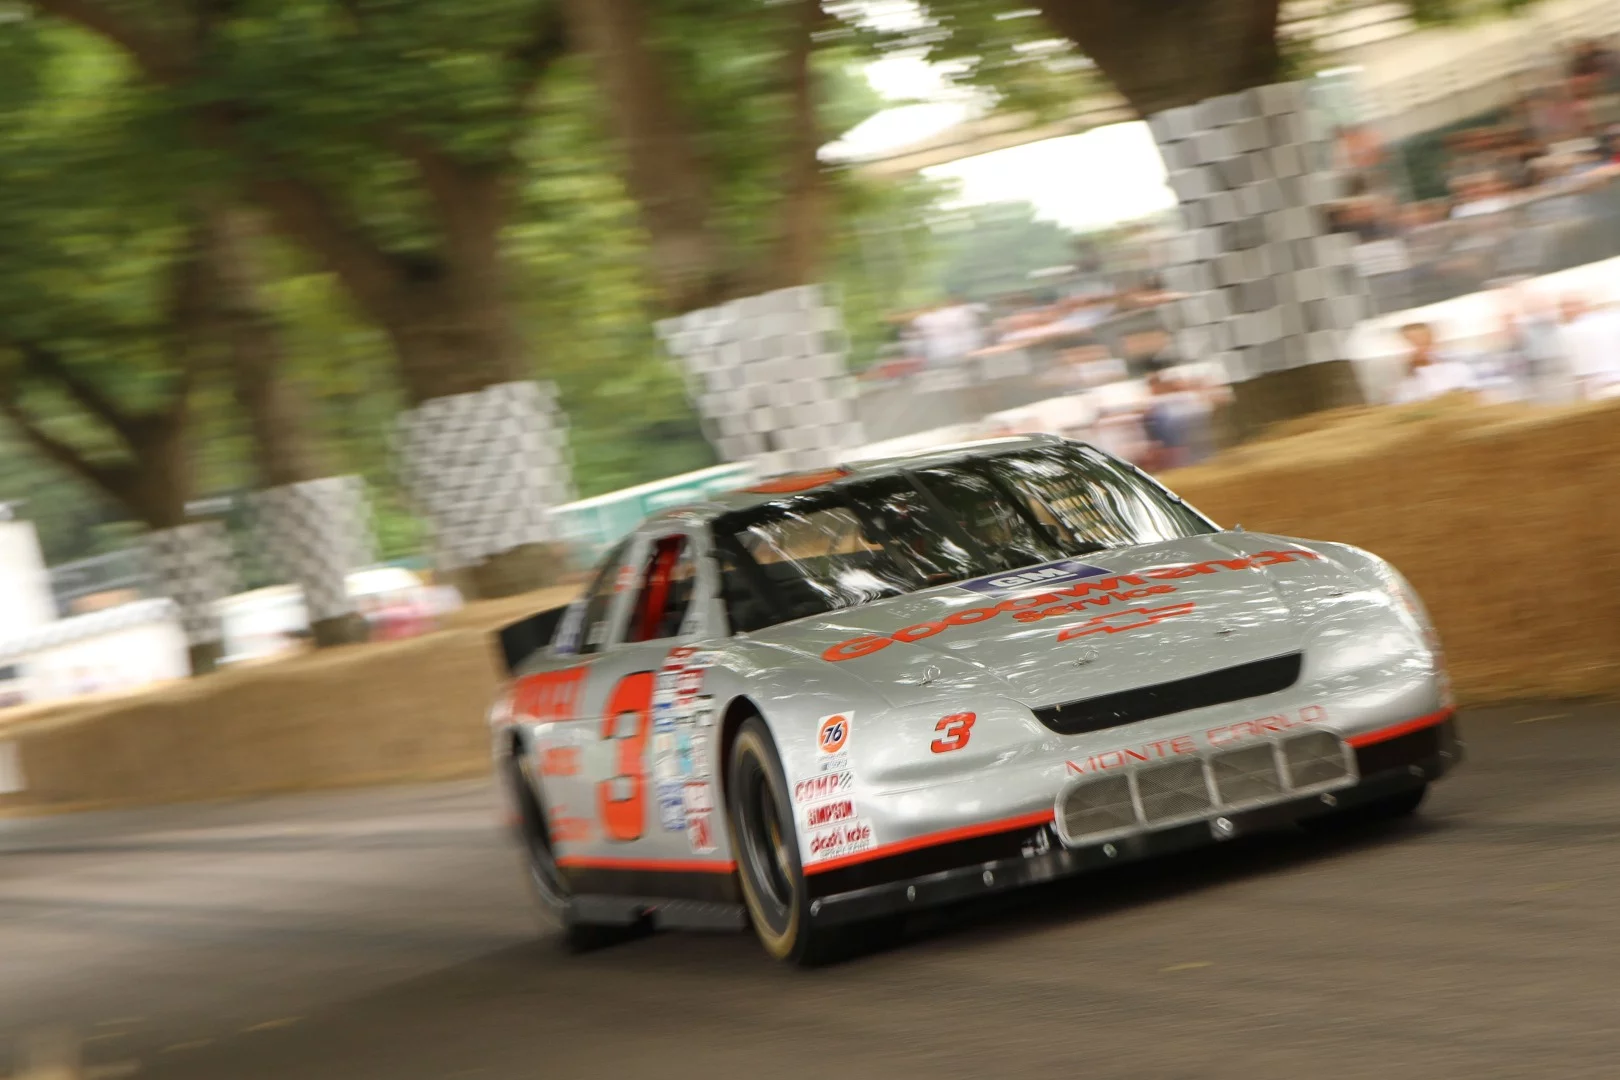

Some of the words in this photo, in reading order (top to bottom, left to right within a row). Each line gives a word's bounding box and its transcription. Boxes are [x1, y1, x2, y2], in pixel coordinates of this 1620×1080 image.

[987, 567, 1071, 590] GM
[1012, 584, 1179, 623] Service
[823, 721, 844, 745] 76
[930, 711, 977, 754] 3
[1064, 735, 1198, 777] MONTE
[1206, 704, 1329, 747] CARLO
[596, 669, 656, 842] 3
[795, 772, 840, 802] COMP
[807, 800, 853, 826] SIMPSON
